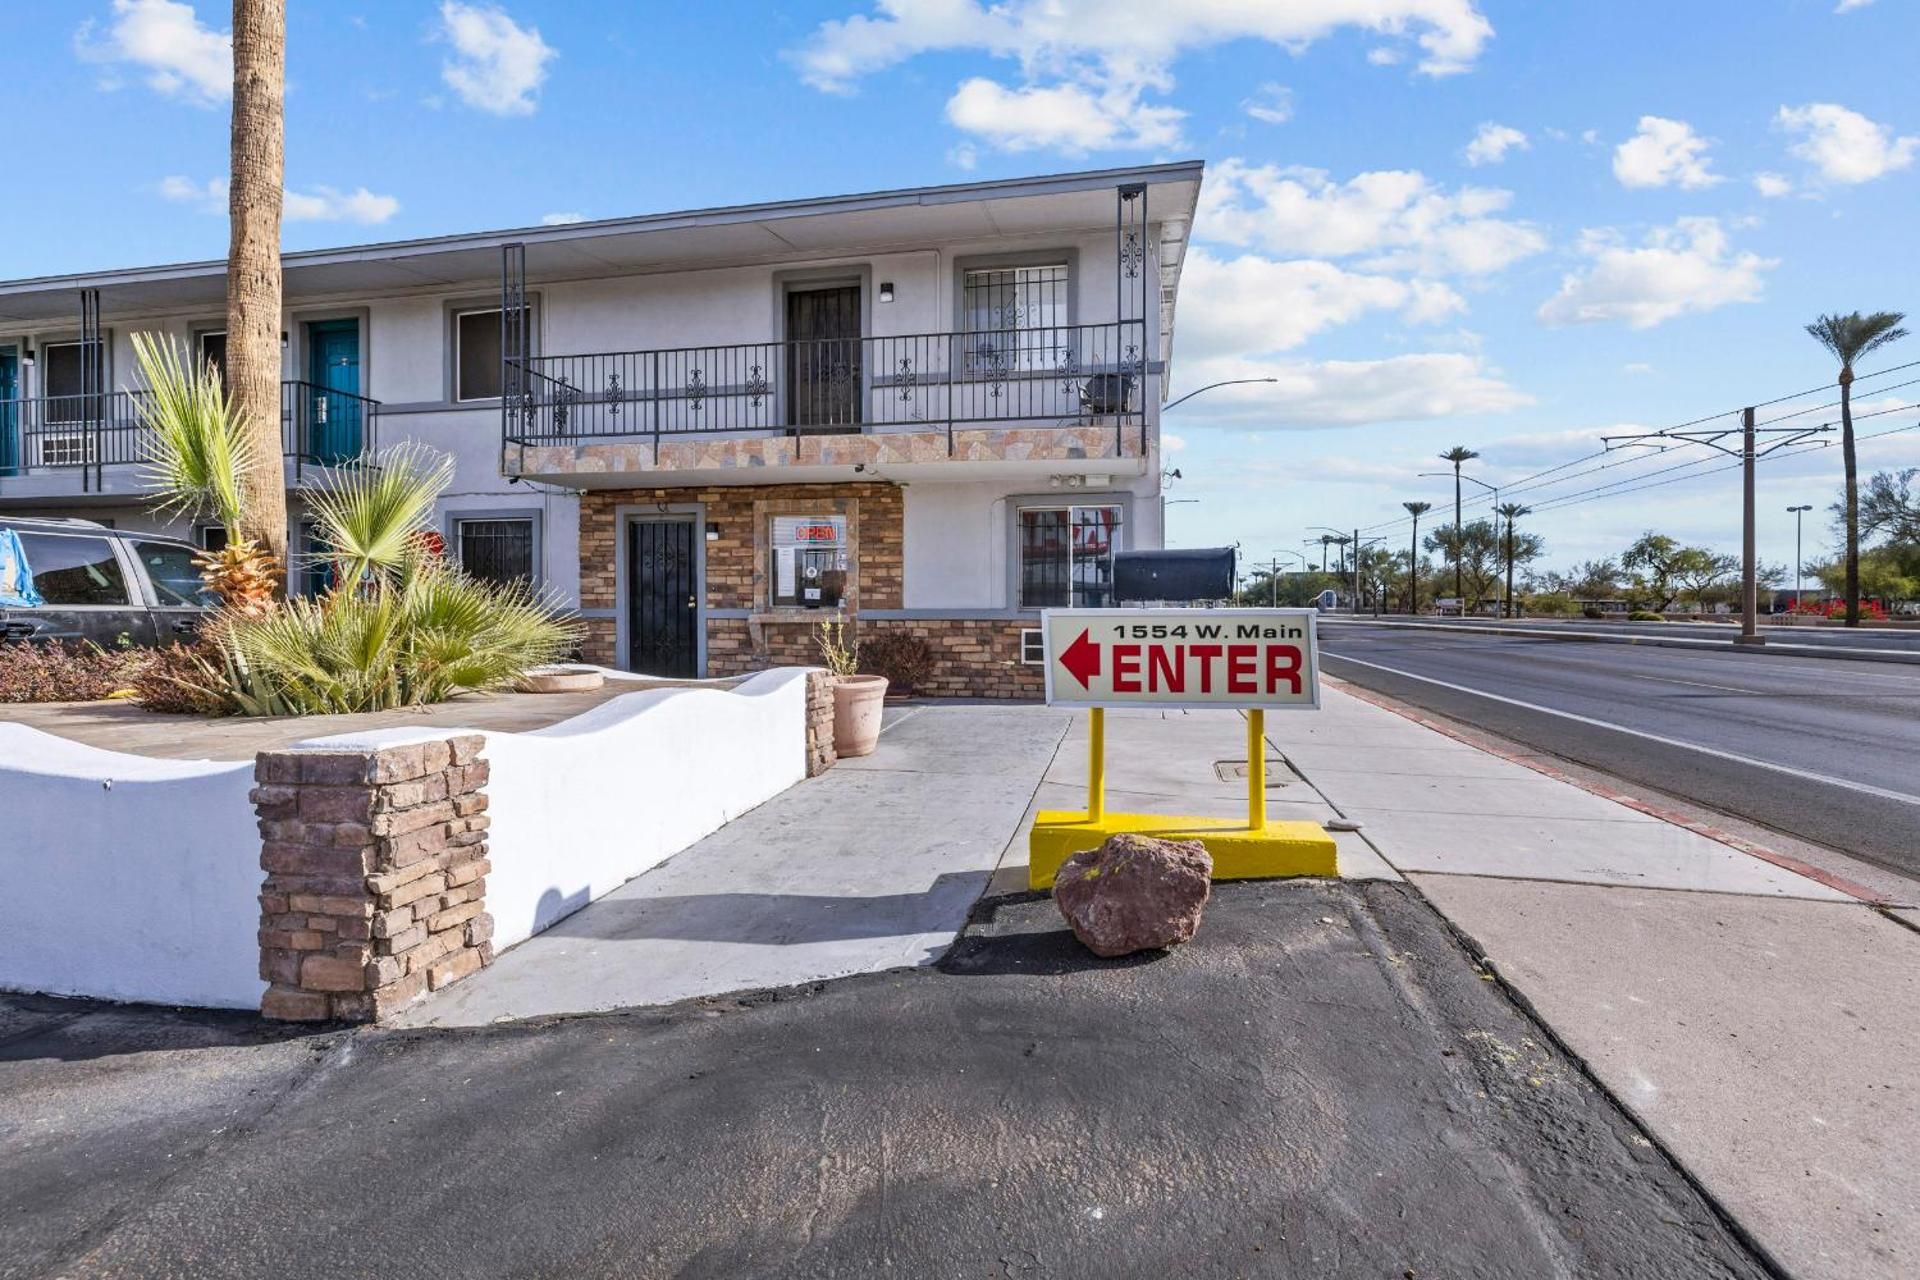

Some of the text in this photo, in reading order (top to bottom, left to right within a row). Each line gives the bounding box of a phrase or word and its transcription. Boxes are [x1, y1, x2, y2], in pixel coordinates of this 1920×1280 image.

[796, 525, 836, 540] OPEN
[1113, 624, 1302, 639] 1554 W. Main
[1113, 644, 1302, 694] ENTER
